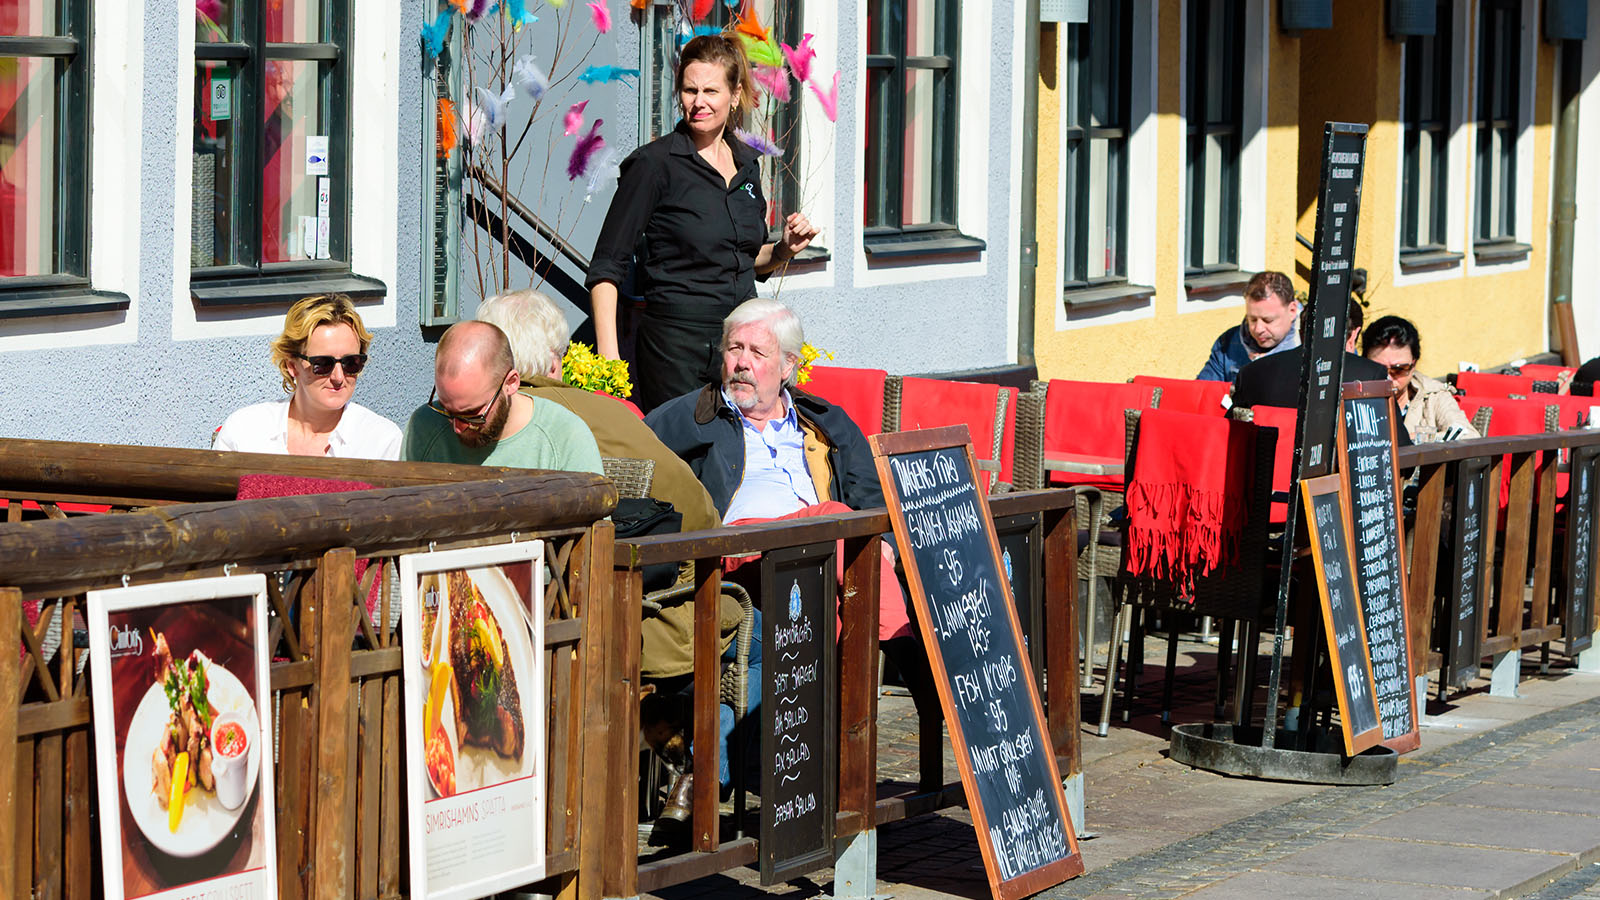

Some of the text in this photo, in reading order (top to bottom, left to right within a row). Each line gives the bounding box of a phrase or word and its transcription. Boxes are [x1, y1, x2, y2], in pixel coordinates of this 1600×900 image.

[1352, 400, 1379, 437] LUNCH
[891, 451, 960, 498] DAGENS TIPS
[944, 548, 963, 586] 95
[931, 577, 992, 641] LAMMSPETT
[791, 659, 818, 691] SKAGEN
[955, 669, 985, 710] FISH
[774, 706, 809, 737] ÄK SALLAD
[989, 698, 1008, 732] 95
[774, 742, 811, 776] AX SALLAD
[970, 744, 1000, 776] MIXAT
[425, 802, 480, 835] SIMRISHAMNS
[773, 792, 817, 828] EASAR SALLAD
